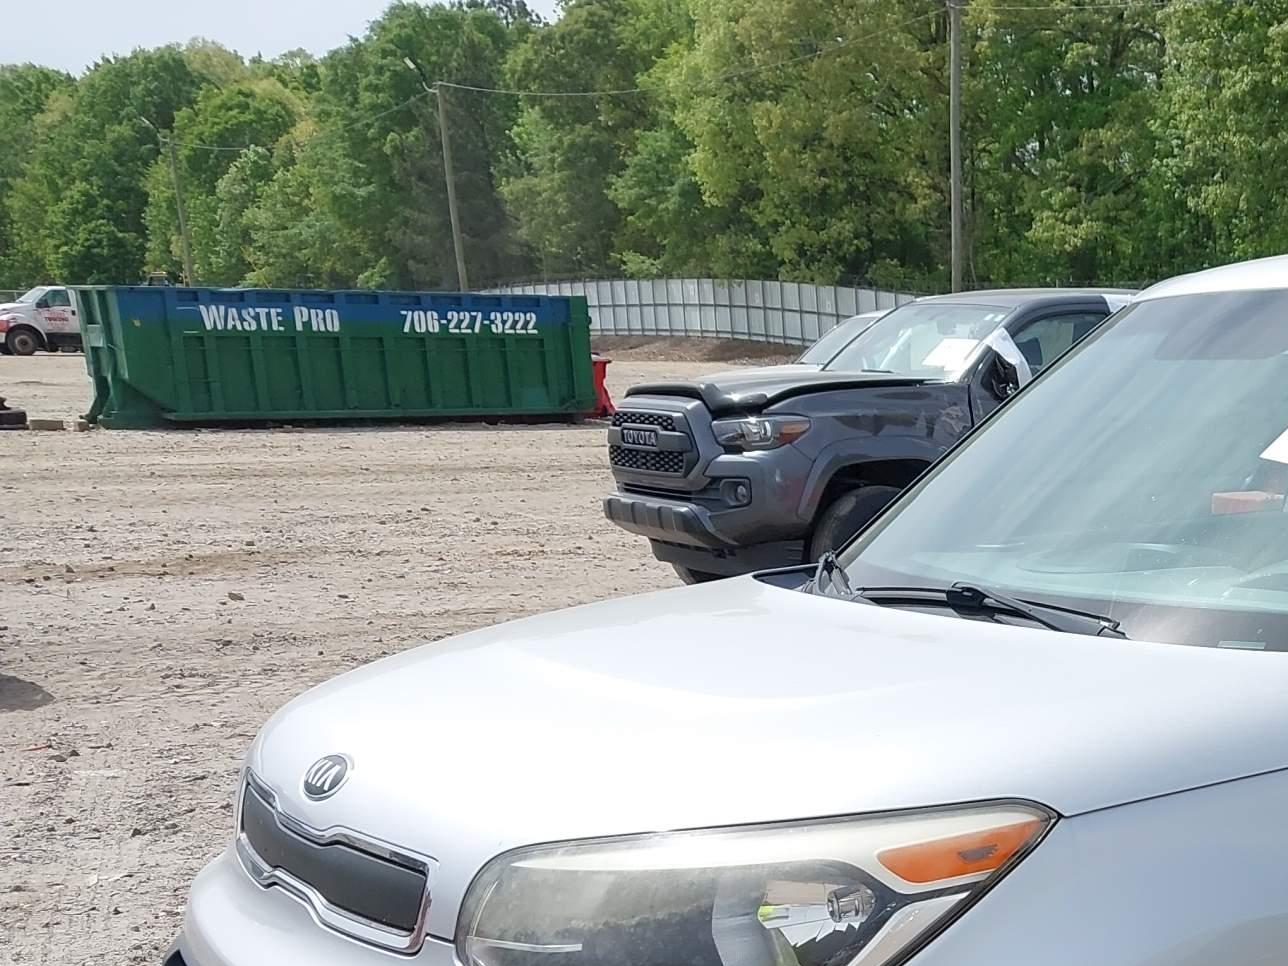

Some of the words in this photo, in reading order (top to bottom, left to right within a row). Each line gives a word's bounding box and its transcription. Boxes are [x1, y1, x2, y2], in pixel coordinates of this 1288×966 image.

[400, 310, 538, 334] 706-227-3222
[623, 429, 657, 446] TOYOTA
[306, 758, 342, 791] KIA
